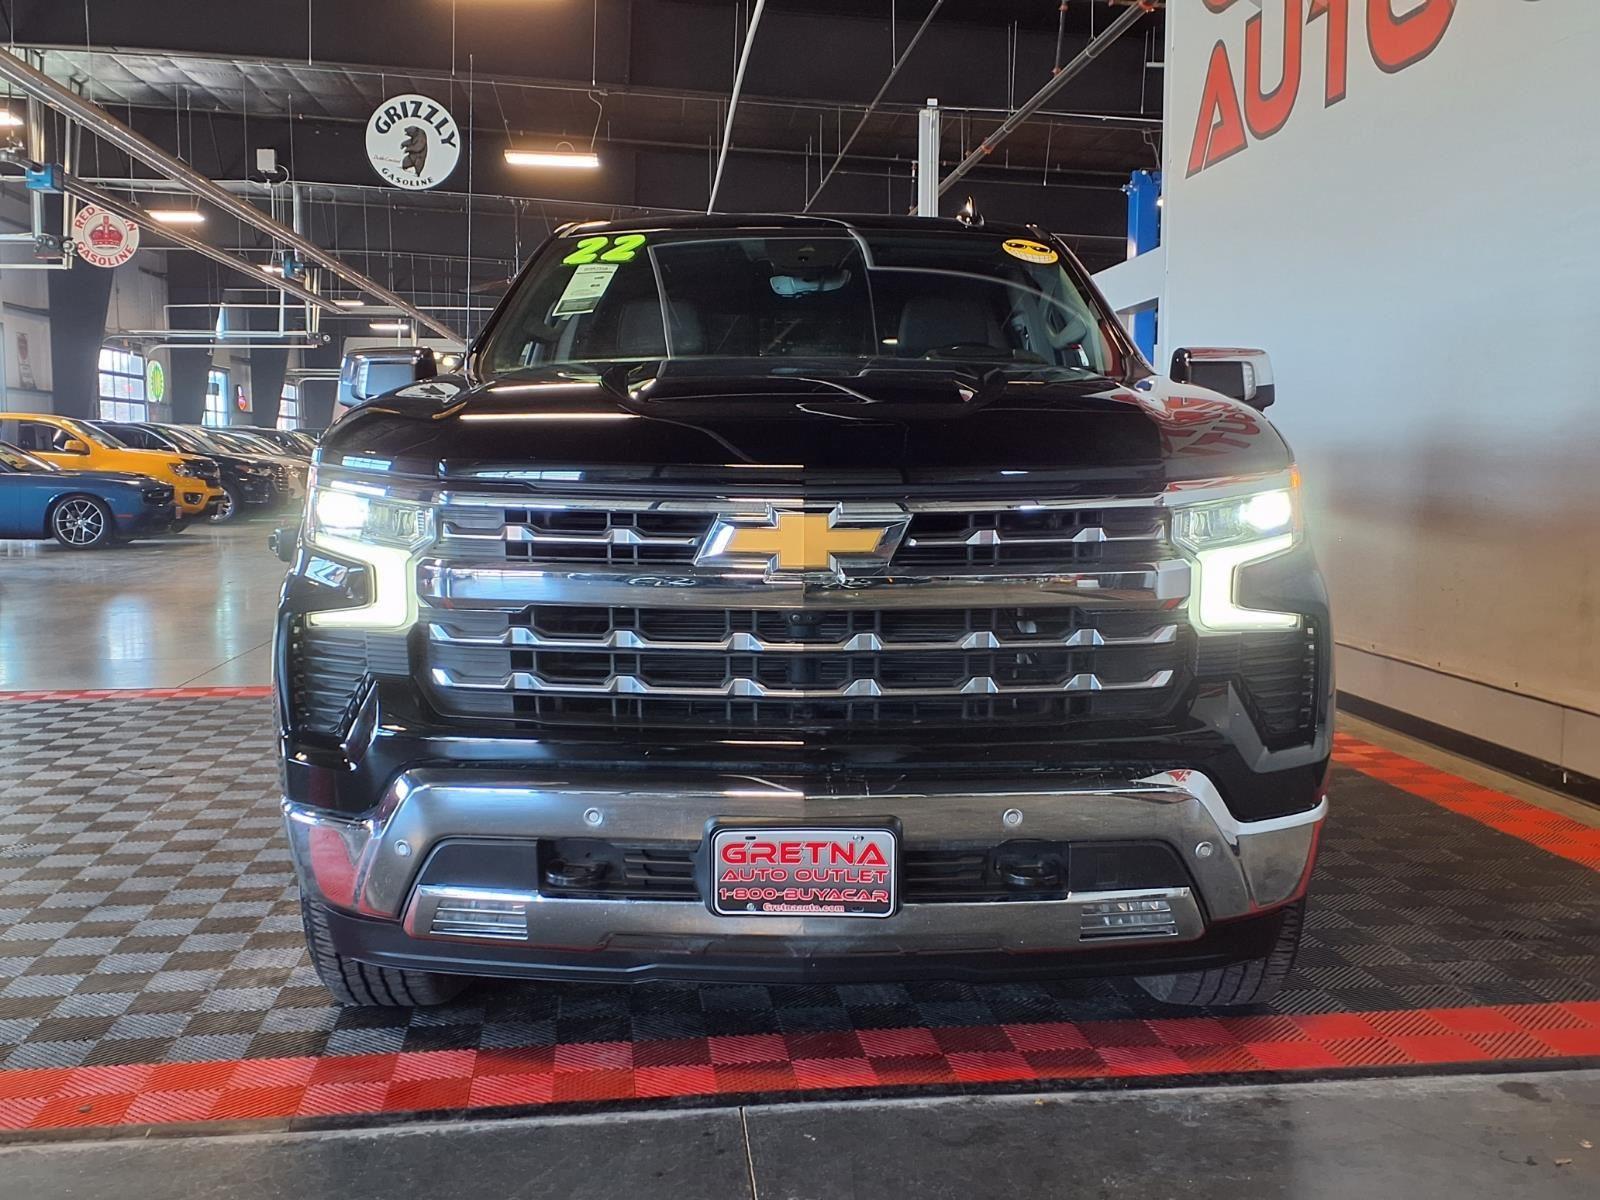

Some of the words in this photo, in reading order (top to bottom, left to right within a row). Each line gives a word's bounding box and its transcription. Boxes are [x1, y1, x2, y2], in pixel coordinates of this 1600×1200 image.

[375, 100, 457, 148] GRIZZLY
[381, 167, 434, 187] GASOLINE
[75, 206, 96, 230] RED
[77, 241, 135, 266] GASOLINE
[562, 234, 646, 265] 22
[720, 840, 889, 866] GRETNA
[720, 868, 788, 882] AUTO
[794, 868, 890, 883] OUTLET
[719, 887, 889, 903] 1-800-BUYACAR
